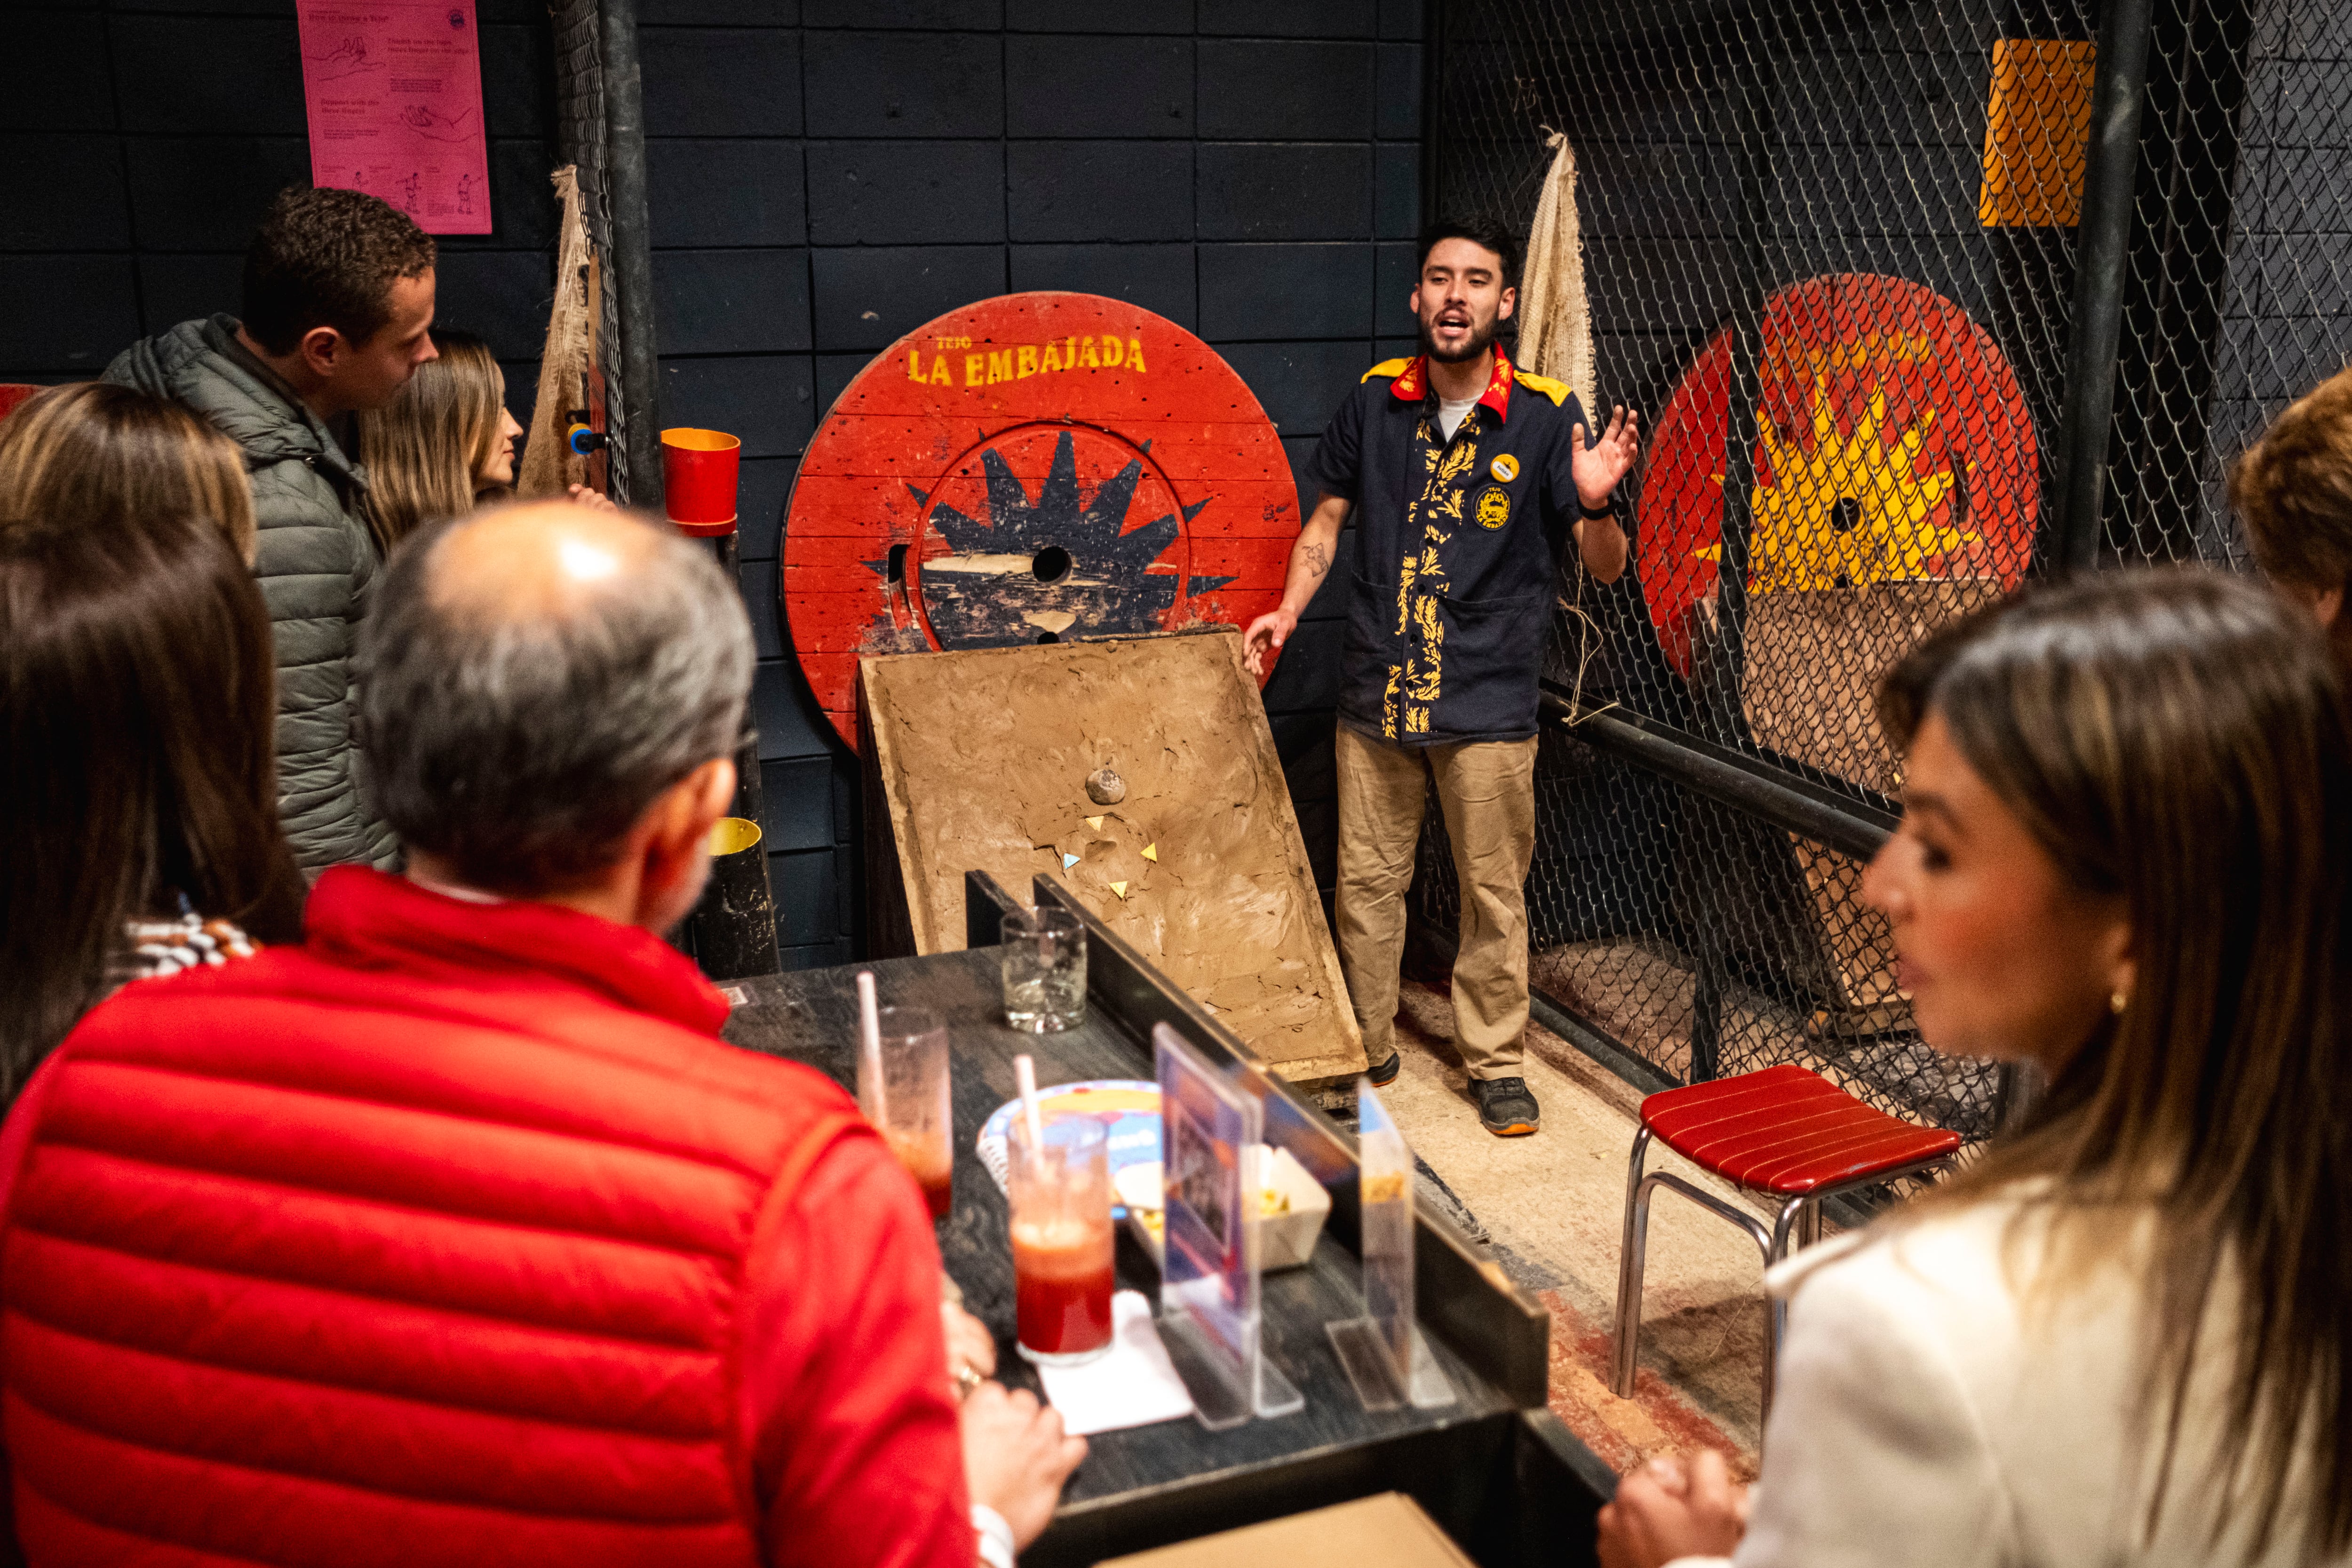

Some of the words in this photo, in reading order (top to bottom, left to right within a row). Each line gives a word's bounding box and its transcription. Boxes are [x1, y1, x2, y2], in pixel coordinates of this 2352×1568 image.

[936, 336, 972, 350] TEJO
[909, 350, 952, 387] LA
[965, 334, 1147, 387] EMBAJADA
